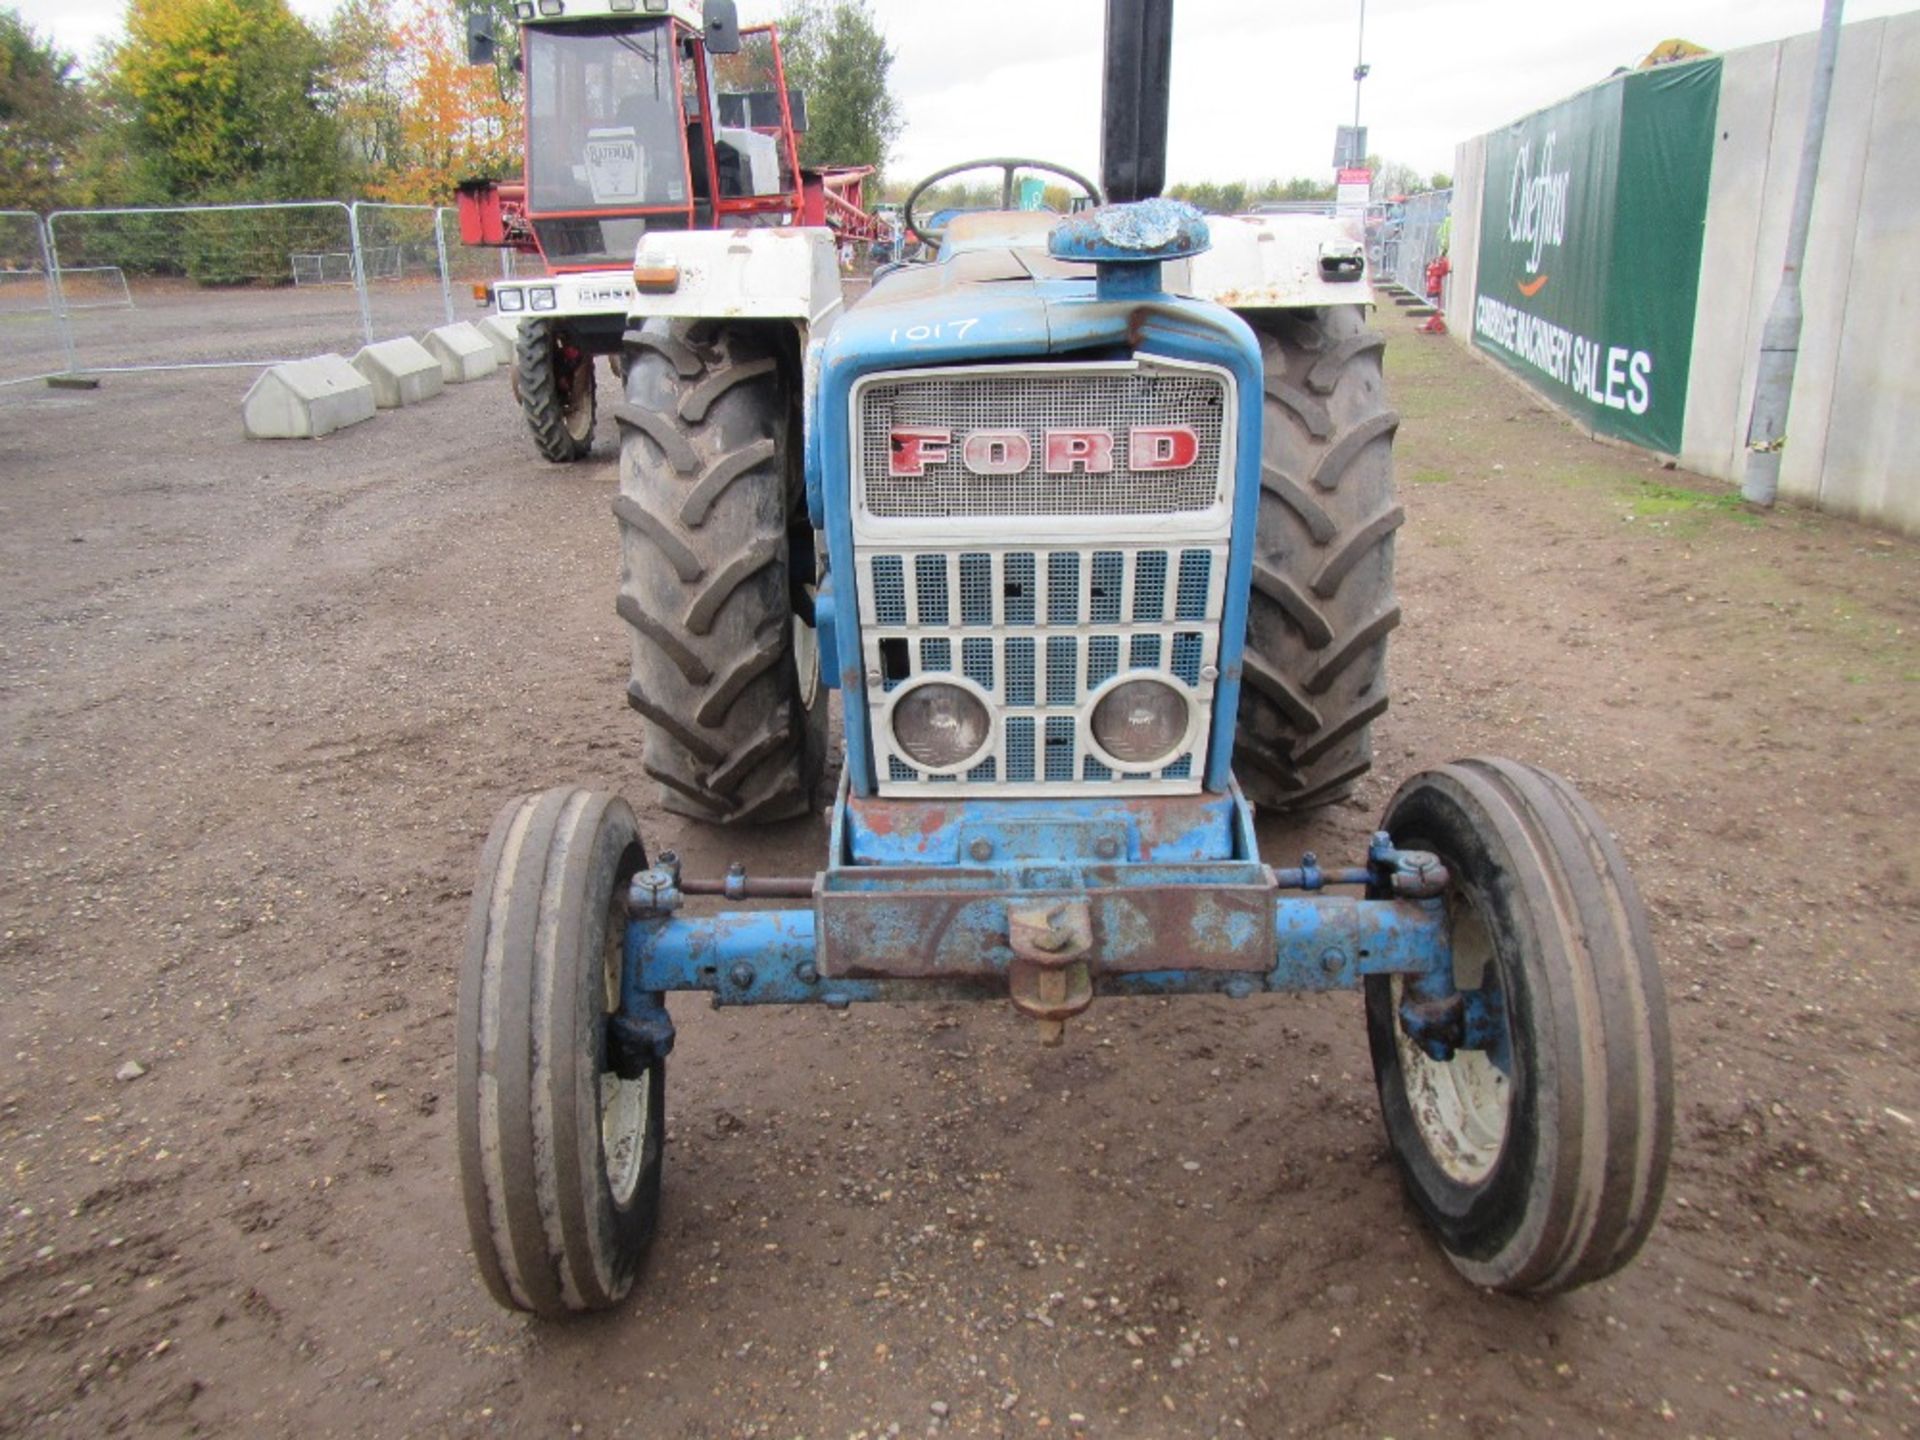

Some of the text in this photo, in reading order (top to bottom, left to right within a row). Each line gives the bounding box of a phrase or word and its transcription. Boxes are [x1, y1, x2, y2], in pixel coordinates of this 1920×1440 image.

[890, 318, 979, 345] 1017
[1515, 310, 1574, 385] MACHINERY
[1572, 335, 1652, 416] SALES
[889, 425, 1199, 477] FORD
